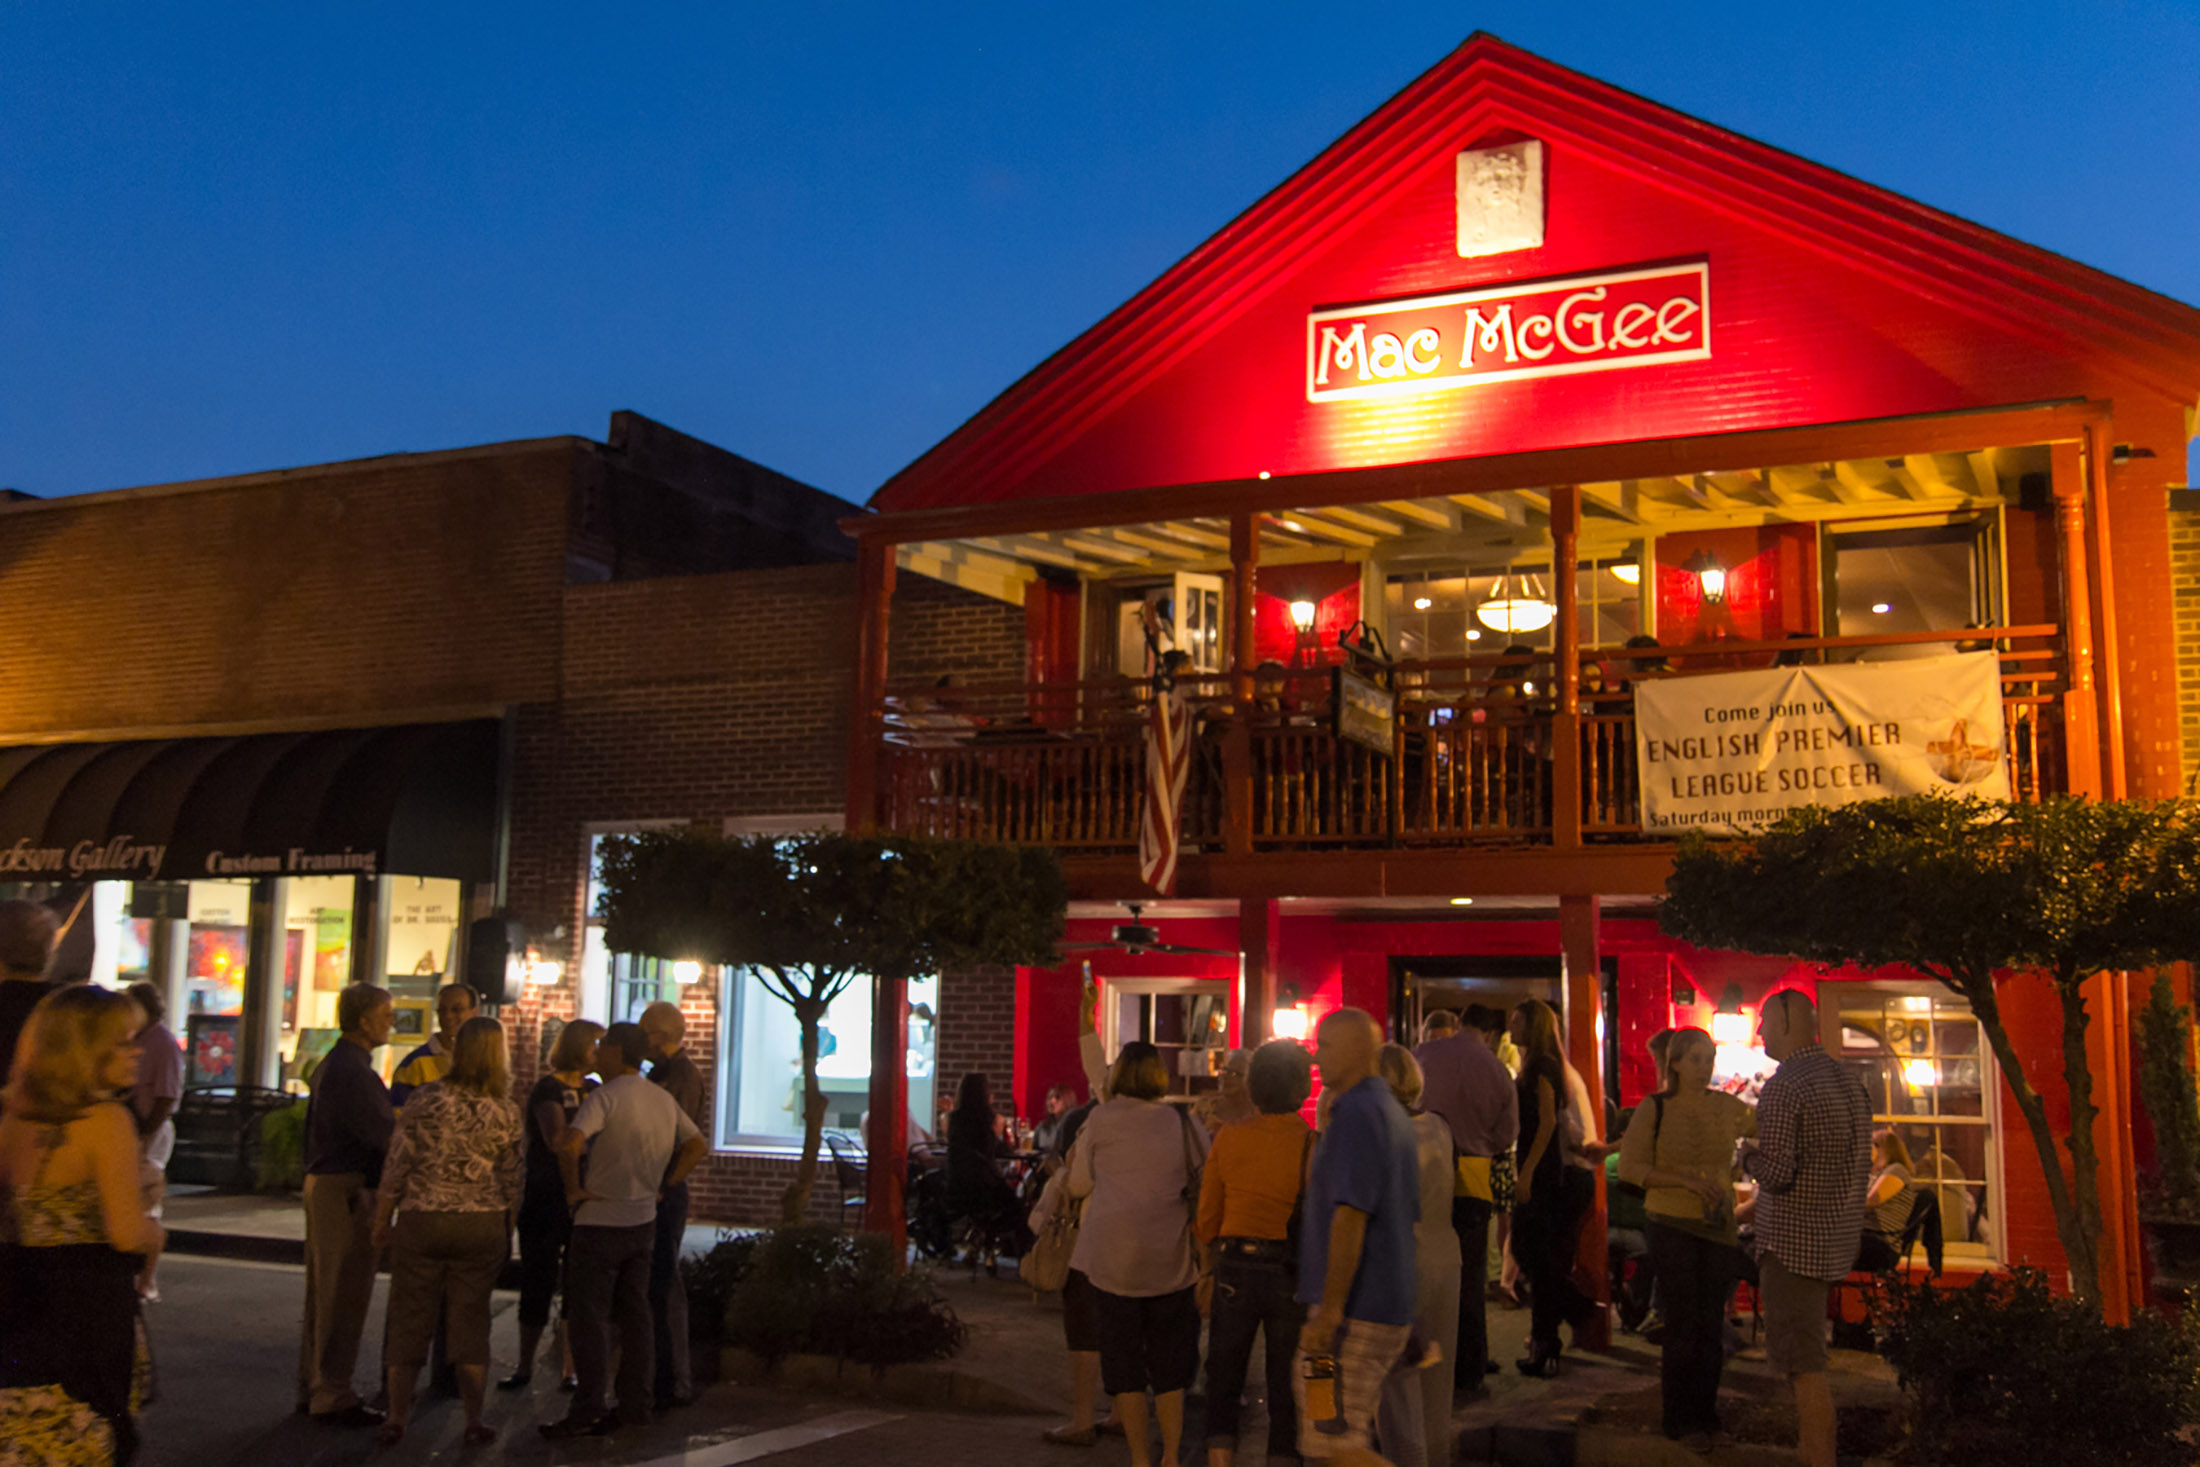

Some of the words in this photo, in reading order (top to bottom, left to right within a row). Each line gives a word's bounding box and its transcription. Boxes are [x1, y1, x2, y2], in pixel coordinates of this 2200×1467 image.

[1316, 322, 1441, 385] Mac
[1459, 286, 1700, 369] McGee
[1704, 706, 1760, 724] Come
[1766, 702, 1806, 722] join
[1813, 700, 1836, 715] us
[1648, 732, 1760, 762] ENGLISH
[1775, 722, 1901, 753] PREMIER
[1671, 769, 1769, 799] LEAGUE
[1778, 762, 1881, 791] SOCCER
[1650, 809, 1732, 827] Saturday
[1737, 808, 1785, 822] morn
[69, 835, 166, 880] Gallery
[206, 851, 281, 873] Custom
[288, 847, 376, 873] Framing
